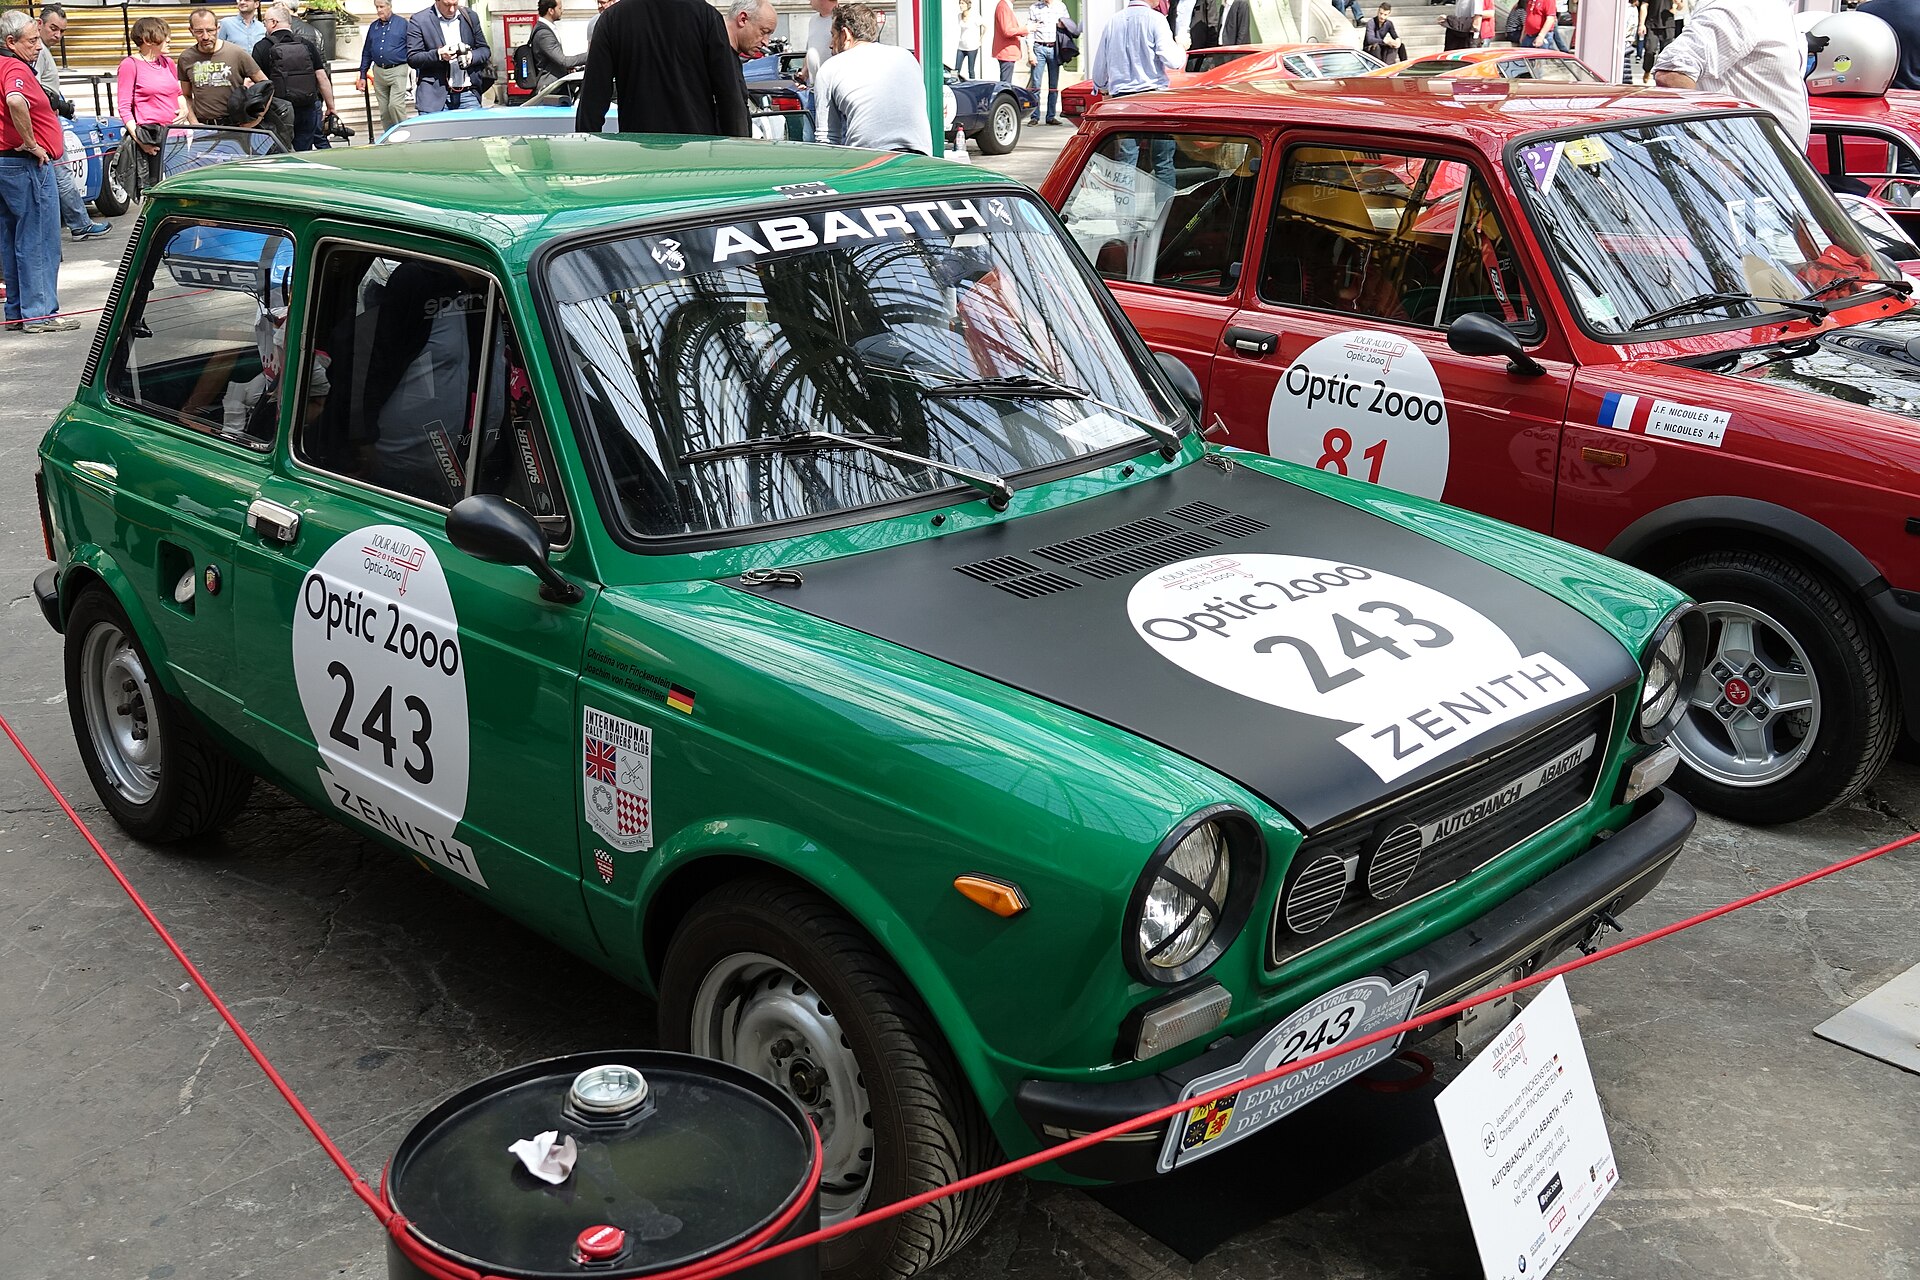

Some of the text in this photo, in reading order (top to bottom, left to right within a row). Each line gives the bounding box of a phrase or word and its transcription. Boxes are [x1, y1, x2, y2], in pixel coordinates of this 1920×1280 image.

[711, 199, 988, 263] ABARTH
[1346, 350, 1385, 366] Optic 2000
[1286, 364, 1443, 426] Optic 2000
[1653, 405, 1726, 425] J.F. NICOULES A+
[429, 430, 462, 488] SANDTLER
[517, 428, 541, 484] SANDTLER
[1315, 427, 1388, 484] 81
[1655, 421, 1721, 441] F. NICOULES A+
[363, 557, 402, 581] Optic 2000
[371, 533, 411, 557] TOUR AUTO
[376, 551, 395, 563] 2018
[305, 573, 459, 676] Optic 2000
[1142, 566, 1372, 642] Optic 2000
[587, 648, 671, 689] Christina von Finckenstein
[1253, 601, 1454, 694] 243
[584, 663, 666, 702] Joachim von Finckenstein
[327, 661, 434, 785] 243
[585, 709, 650, 745] INTERNATIONAL
[585, 723, 650, 756] RALLY DRIVERS CLUB
[1371, 663, 1566, 760] ZENITH
[1432, 747, 1584, 843] AUTOBIANCHI ABARTH
[333, 782, 472, 875] ZENITH
[1274, 989, 1372, 1044] 23-28 AVRIL 2018
[1277, 1006, 1357, 1068] 243
[1234, 1049, 1377, 1134] DE ROTHSCHILD
[1243, 1061, 1326, 1112] EDMOND
[1495, 1058, 1555, 1128] Joachim von FINCKENSTEIN
[1497, 1052, 1523, 1080] Optic 2000
[1499, 1071, 1560, 1142] Christina von FINCKENSTEIN
[1483, 1131, 1496, 1150] 243
[1491, 1141, 1528, 1189] AUTOBIANCHI
[1527, 1128, 1540, 1146] A112
[1538, 1104, 1559, 1135] ABARTH
[1562, 1088, 1574, 1107] 1975
